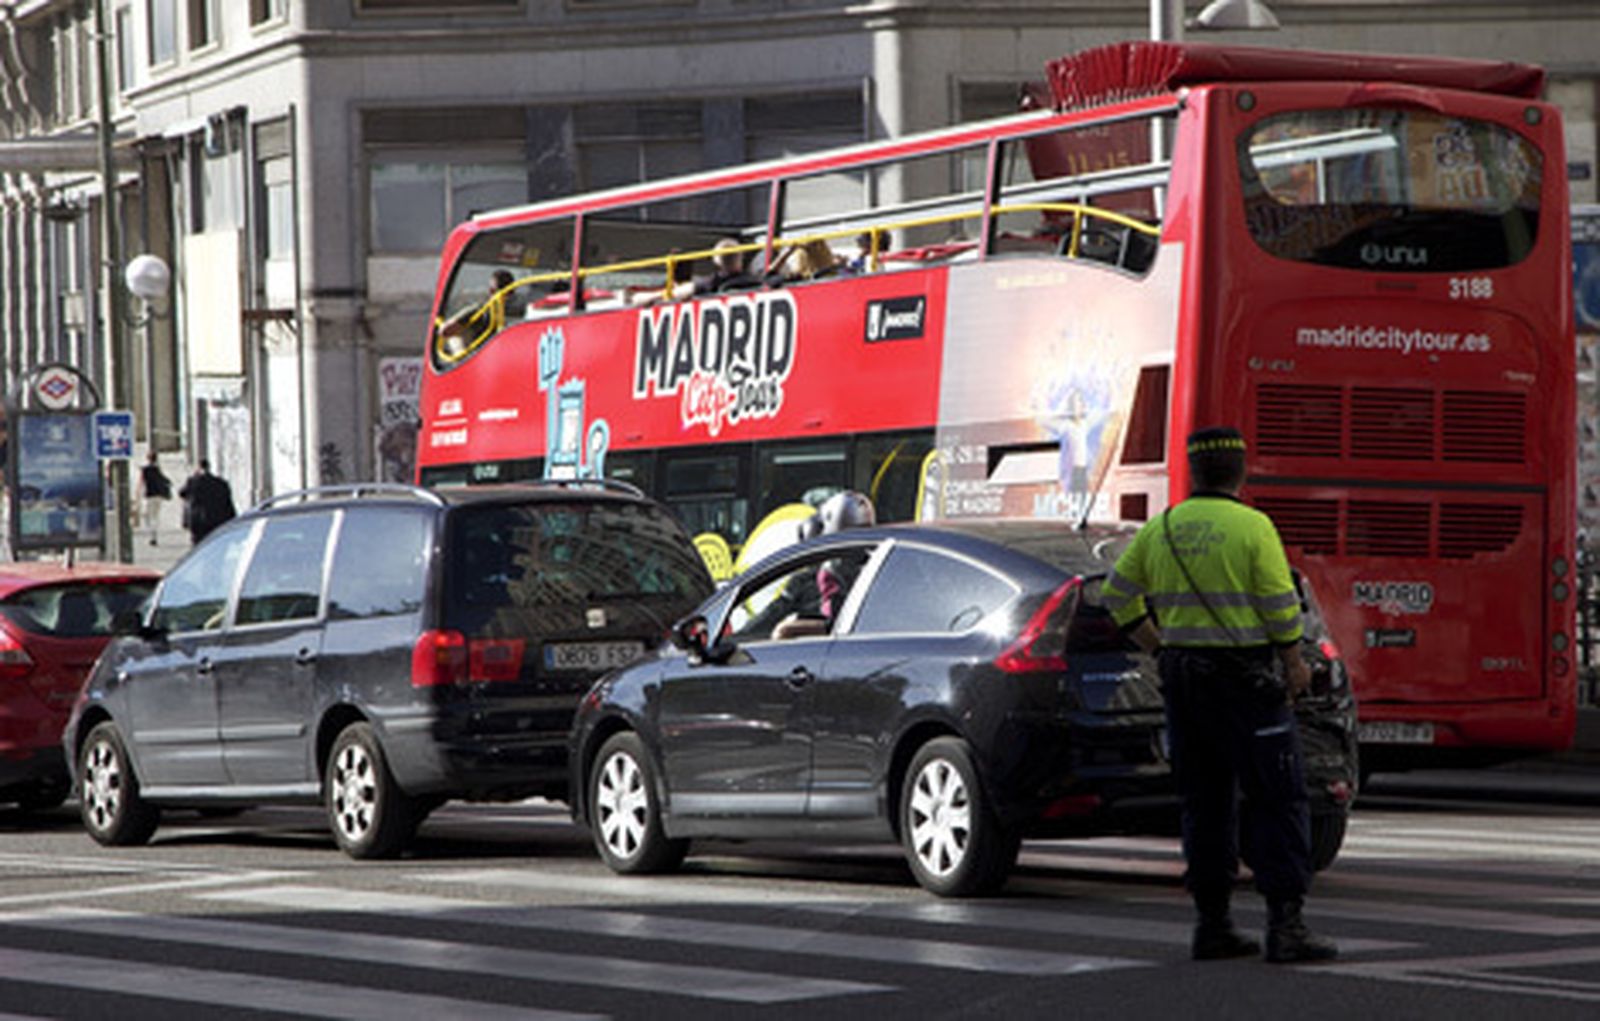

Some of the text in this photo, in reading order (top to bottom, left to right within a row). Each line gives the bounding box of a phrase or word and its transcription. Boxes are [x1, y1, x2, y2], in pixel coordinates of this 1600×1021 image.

[632, 289, 797, 399] MADRID
[1296, 325, 1491, 355] madridcitytour.es
[1353, 582, 1434, 606] MADRID
